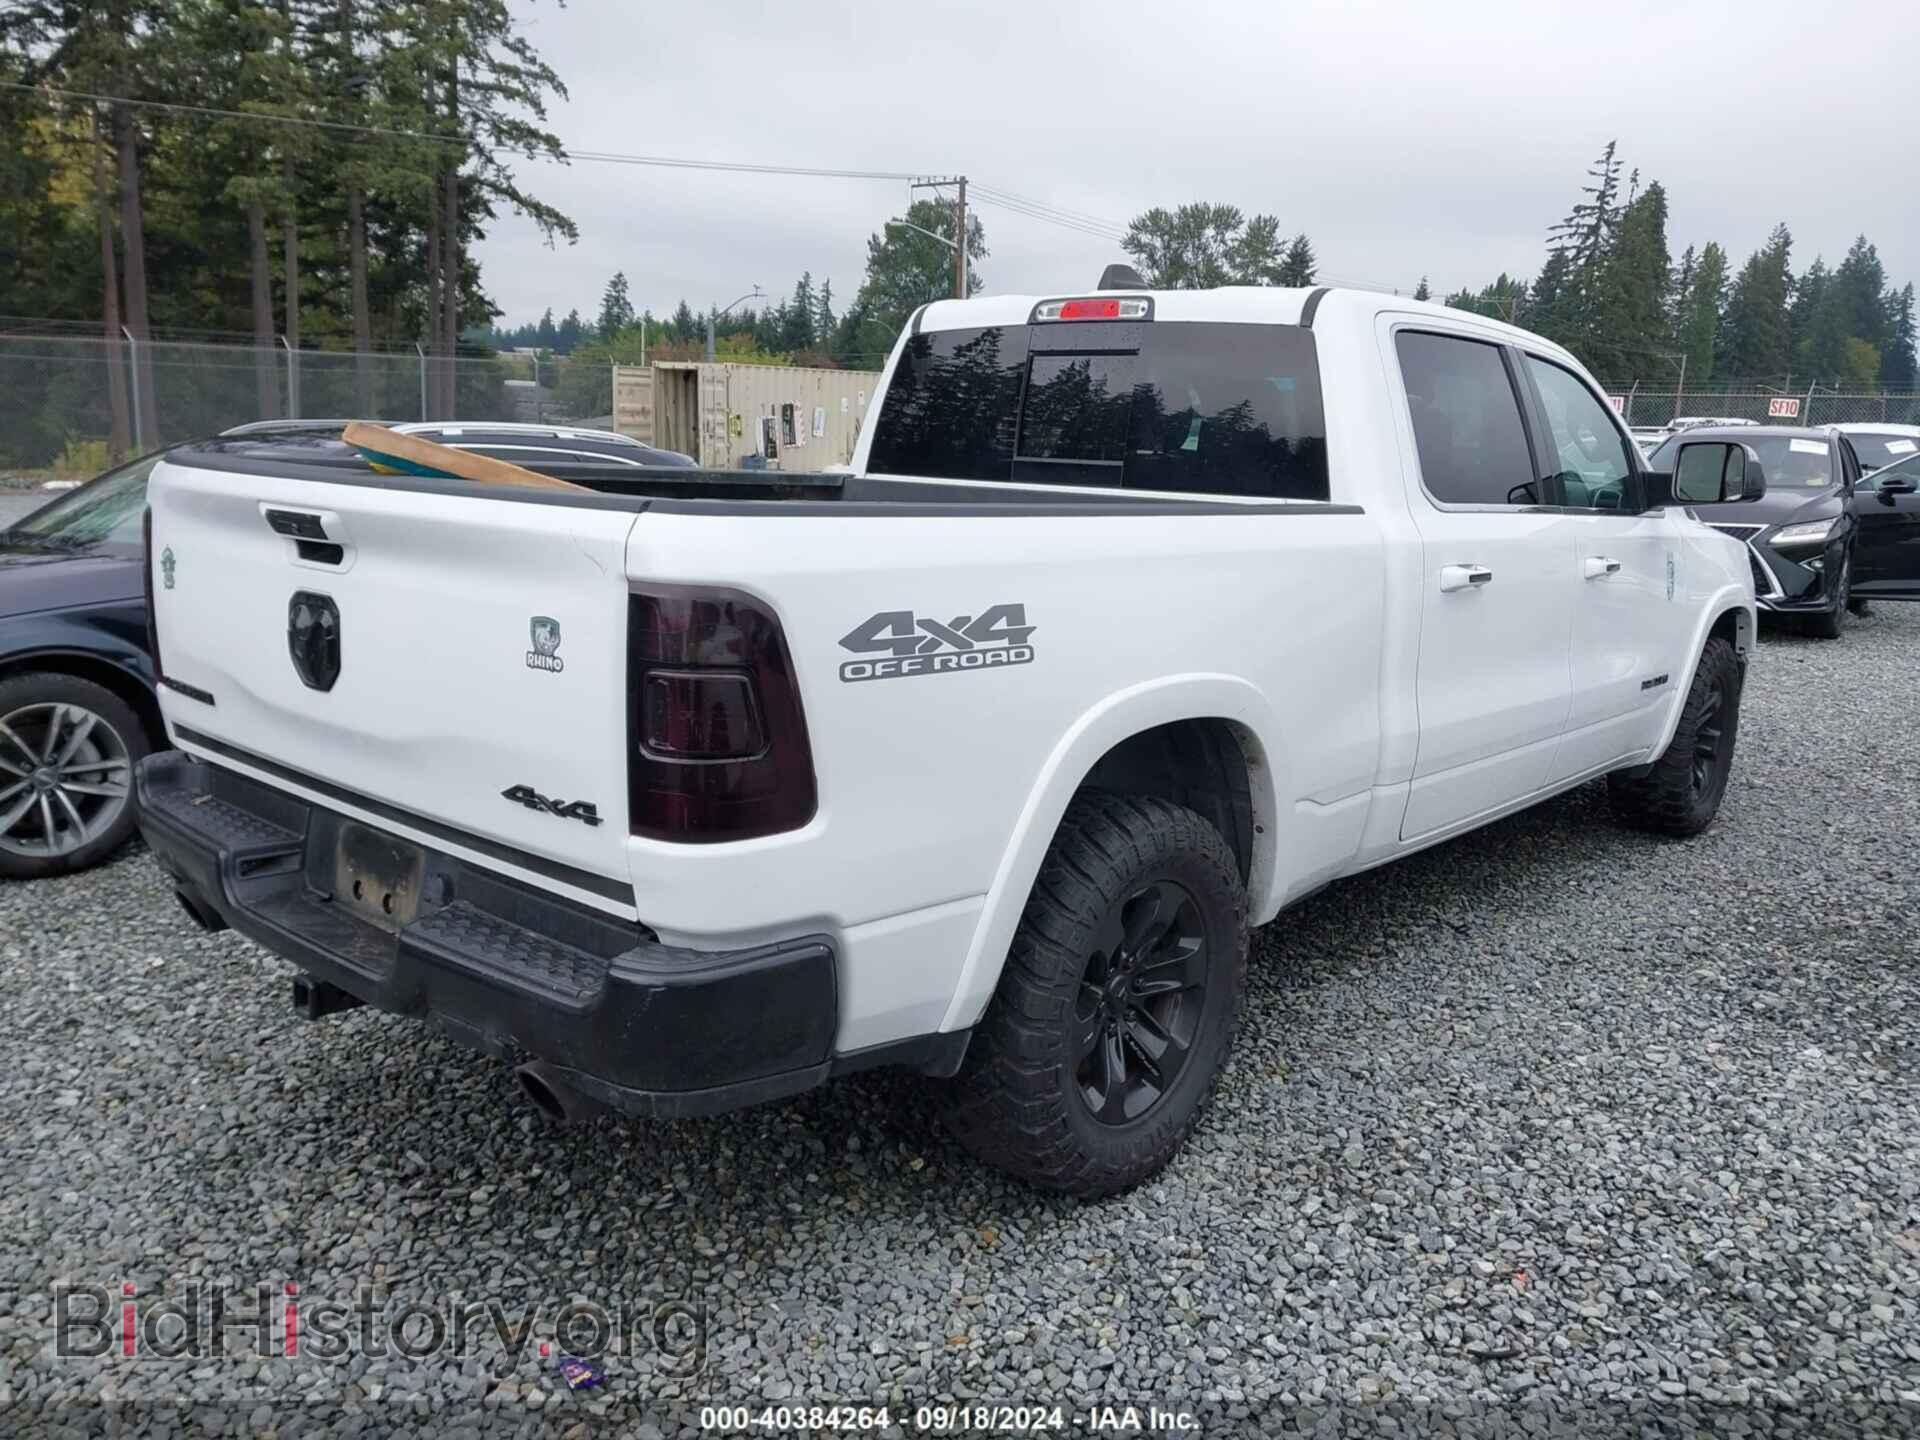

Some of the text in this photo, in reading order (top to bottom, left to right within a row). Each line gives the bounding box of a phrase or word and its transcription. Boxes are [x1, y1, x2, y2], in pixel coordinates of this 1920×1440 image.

[1770, 400, 1799, 416] SF10
[527, 652, 563, 672] RHINO
[843, 647, 1031, 679] OFF ROAD
